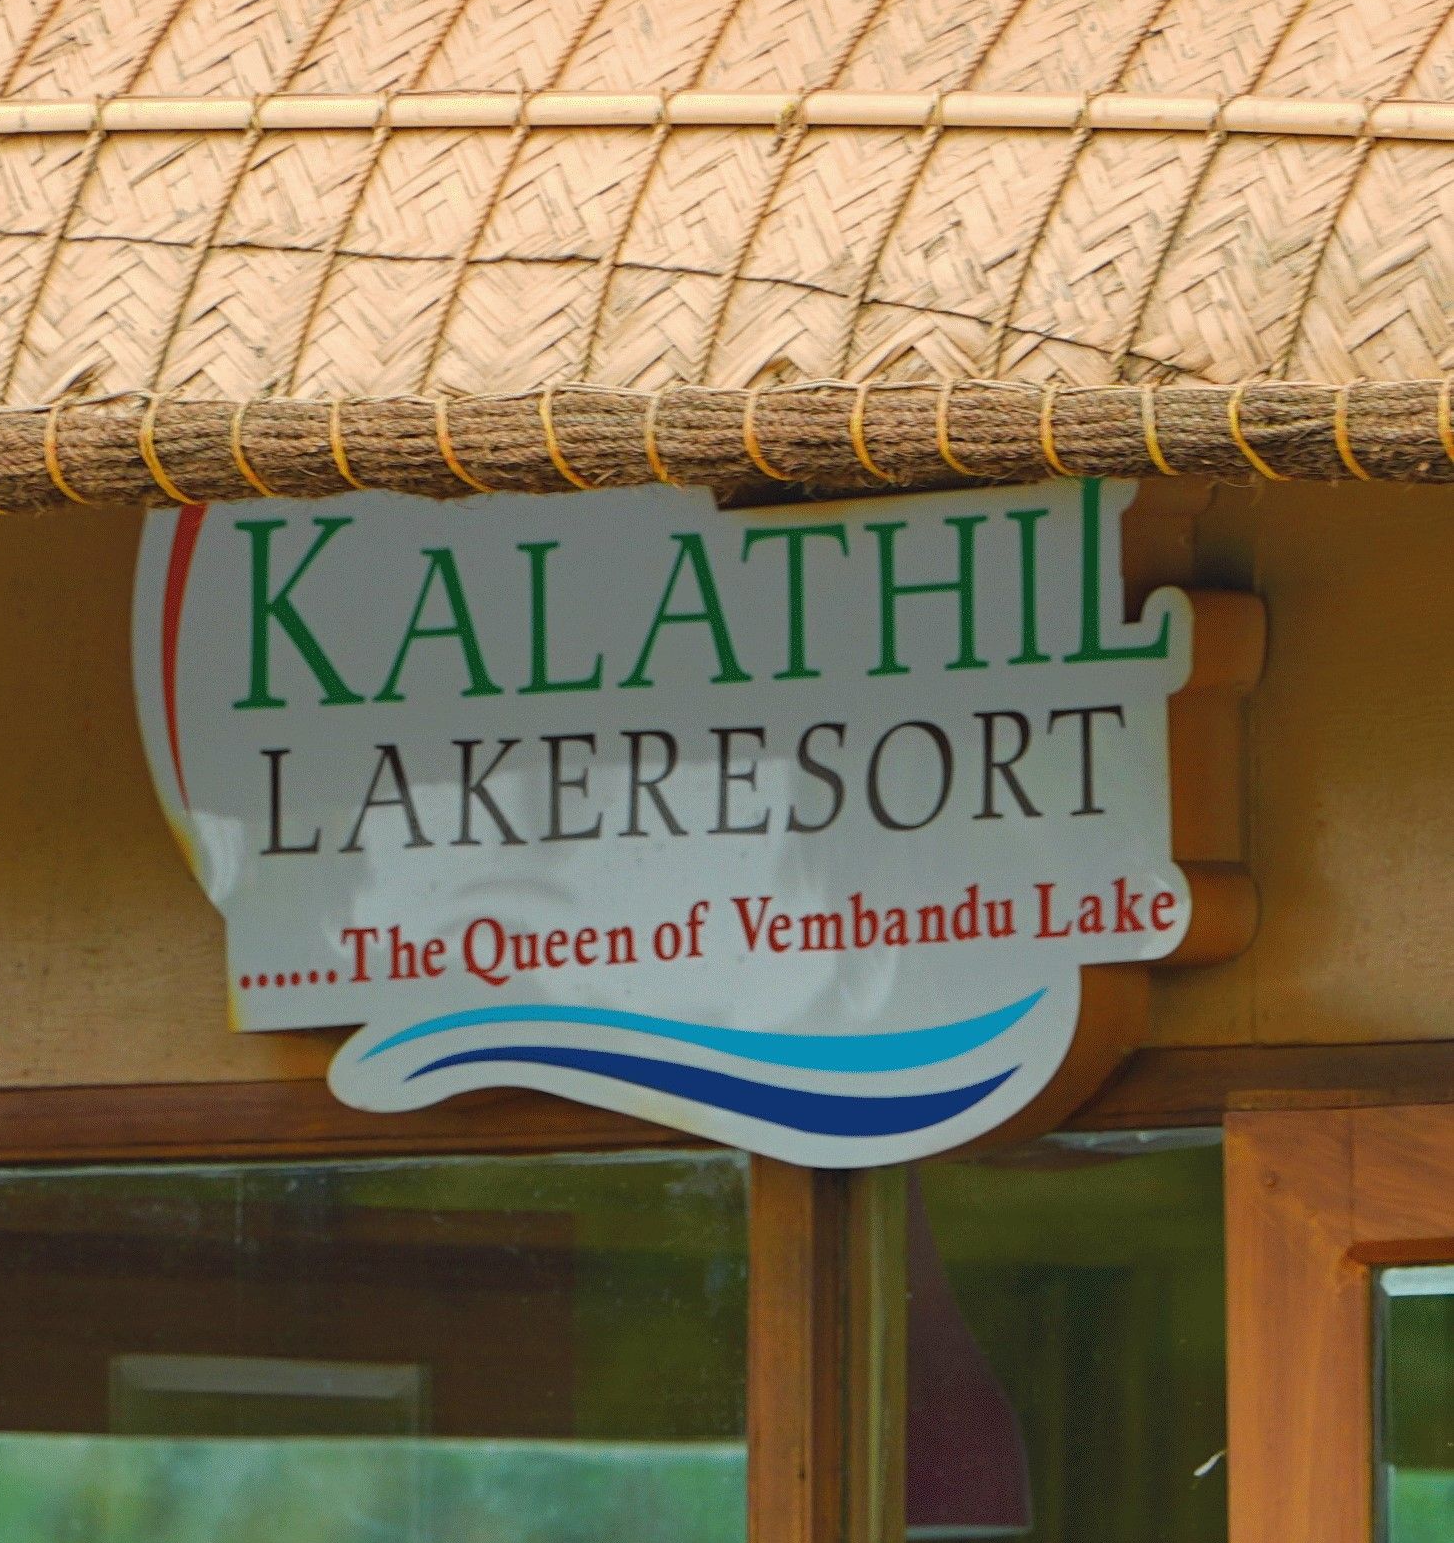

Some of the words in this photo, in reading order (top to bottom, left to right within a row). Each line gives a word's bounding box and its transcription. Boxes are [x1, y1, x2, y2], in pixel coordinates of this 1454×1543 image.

[232, 477, 1171, 710] KALATHIL
[259, 705, 1126, 856] LAKERESORT
[461, 915, 639, 986] Queen
[652, 900, 710, 960] of
[731, 881, 1017, 954] Vembandu
[1032, 876, 1178, 939] Lake
